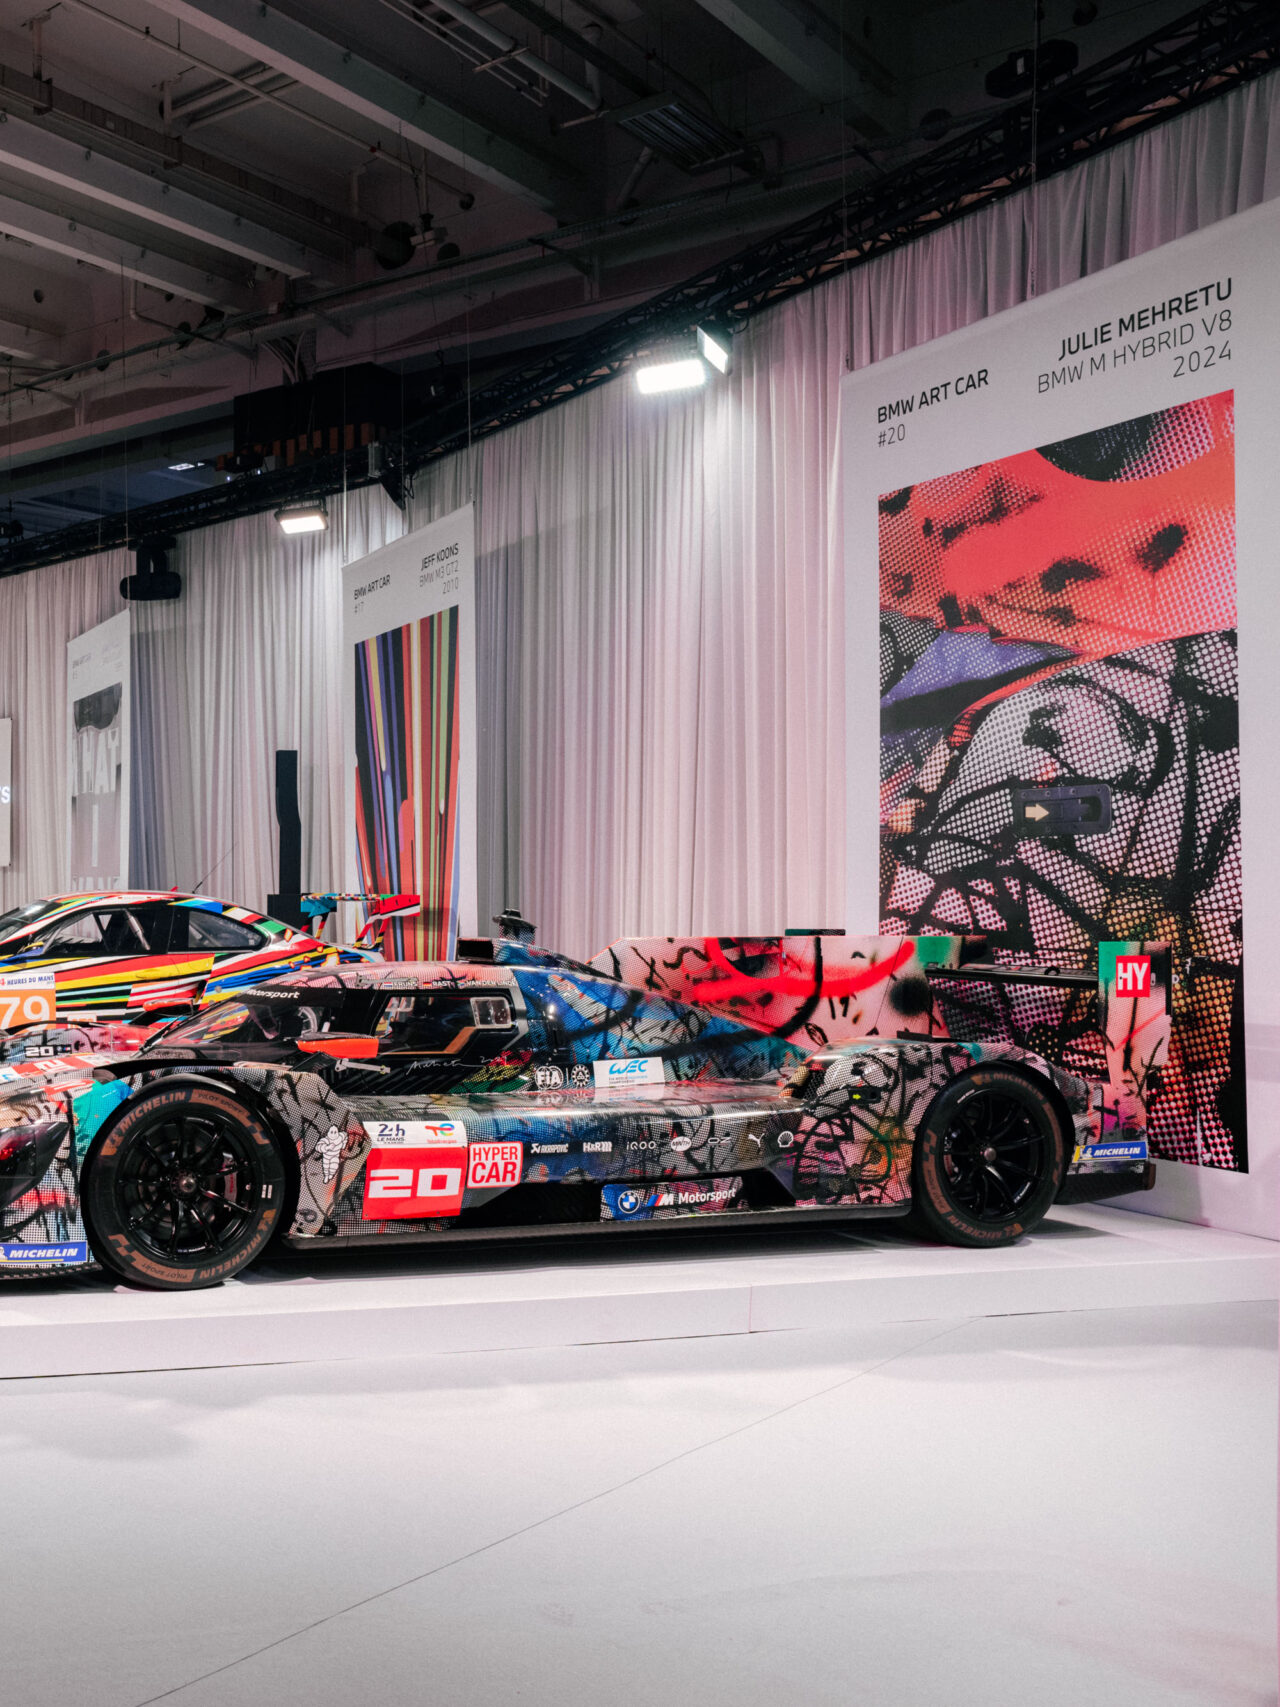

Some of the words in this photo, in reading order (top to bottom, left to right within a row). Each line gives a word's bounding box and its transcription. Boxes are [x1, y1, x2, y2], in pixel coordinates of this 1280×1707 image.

[1058, 321, 1113, 361] JULIE
[1118, 277, 1233, 335] MEHRETU
[1037, 361, 1084, 394] BMW
[1089, 352, 1107, 373] M
[1113, 322, 1195, 370] HYBRID
[1201, 308, 1233, 337] V8
[1171, 340, 1233, 379] 2024
[877, 394, 915, 424] BMW
[918, 381, 951, 410] ART
[954, 369, 989, 396] CAR
[877, 423, 907, 448] #20
[421, 553, 436, 571] JEFF
[436, 543, 459, 562] KOONS
[419, 573, 435, 588] BMW
[446, 560, 459, 575] GT2
[442, 577, 459, 594] 2010
[354, 586, 367, 601] BMW
[367, 579, 379, 593] ART
[379, 574, 391, 588] CAR
[7, 977, 28, 986] HEURES
[28, 976, 37, 984] DU
[37, 975, 55, 983] MANS
[1117, 962, 1149, 991] HY
[25, 1046, 55, 1057] 20
[608, 1059, 649, 1075] WEC
[117, 1090, 188, 1136] MICHELIN
[472, 1145, 519, 1162] HYPER
[626, 1140, 657, 1151] iQOO
[1093, 1146, 1141, 1158] MICHELIN
[367, 1167, 463, 1199] 20
[471, 1160, 518, 1184] CAR
[678, 1187, 738, 1206] Motorsport
[9, 1247, 79, 1259] MICHELIN
[199, 1233, 263, 1280] MICHELIN
